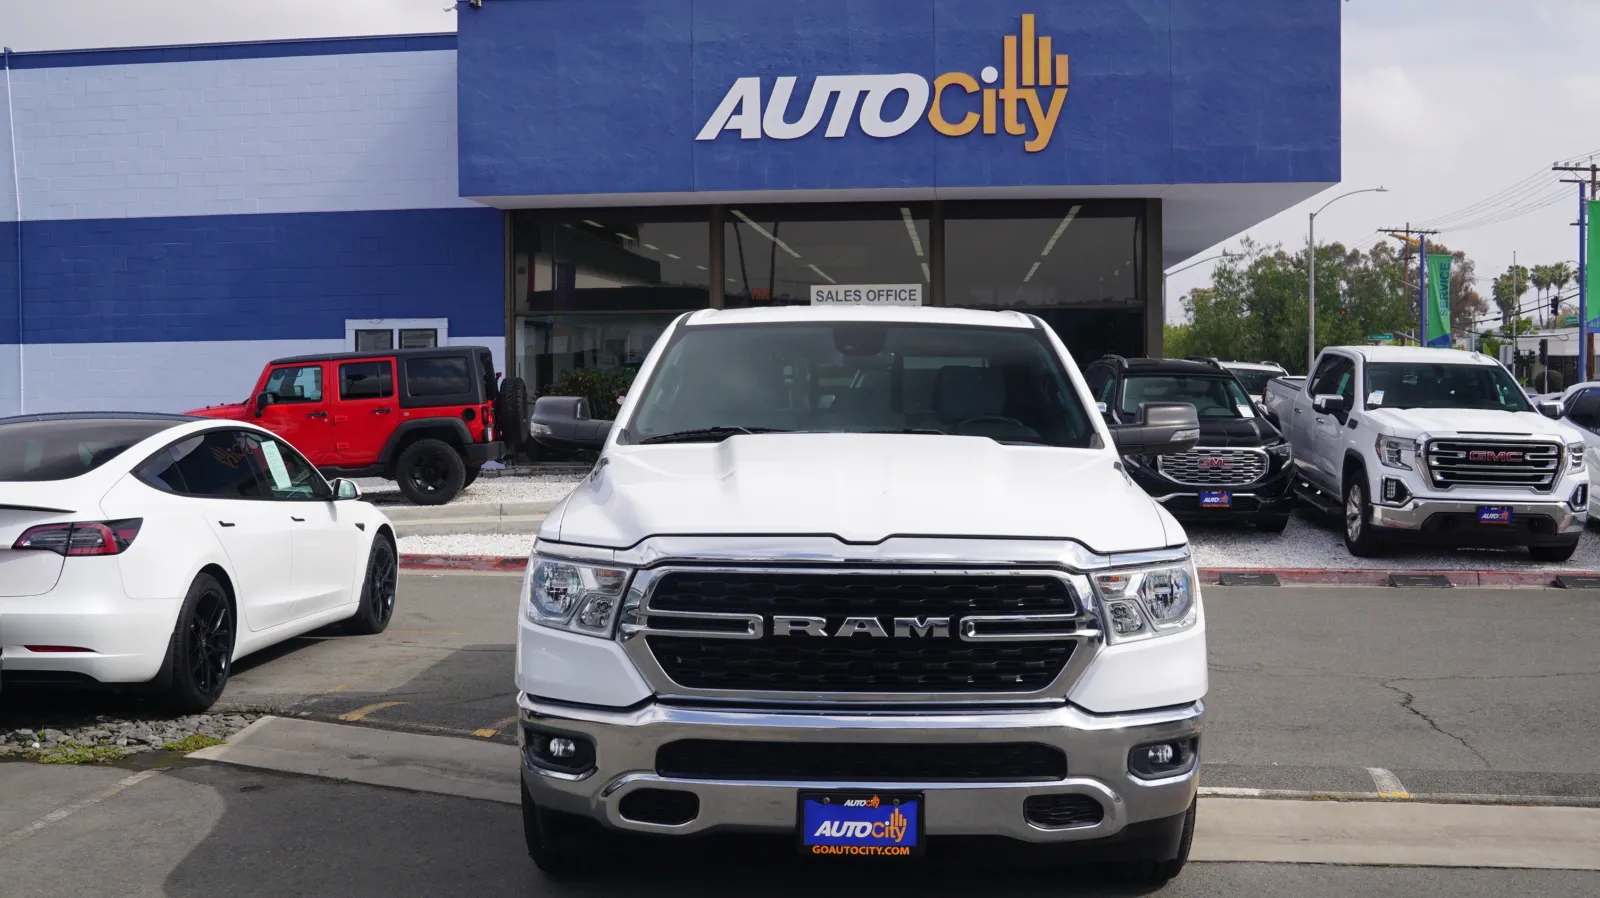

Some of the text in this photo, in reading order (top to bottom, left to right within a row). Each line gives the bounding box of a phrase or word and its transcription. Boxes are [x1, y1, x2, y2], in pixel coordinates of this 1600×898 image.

[816, 289, 917, 302] SALES OFFICE
[1469, 450, 1523, 462] GMC
[1198, 457, 1233, 468] GMC
[773, 615, 950, 638] RAM
[812, 845, 909, 855] GOAUTOCITY.COM
